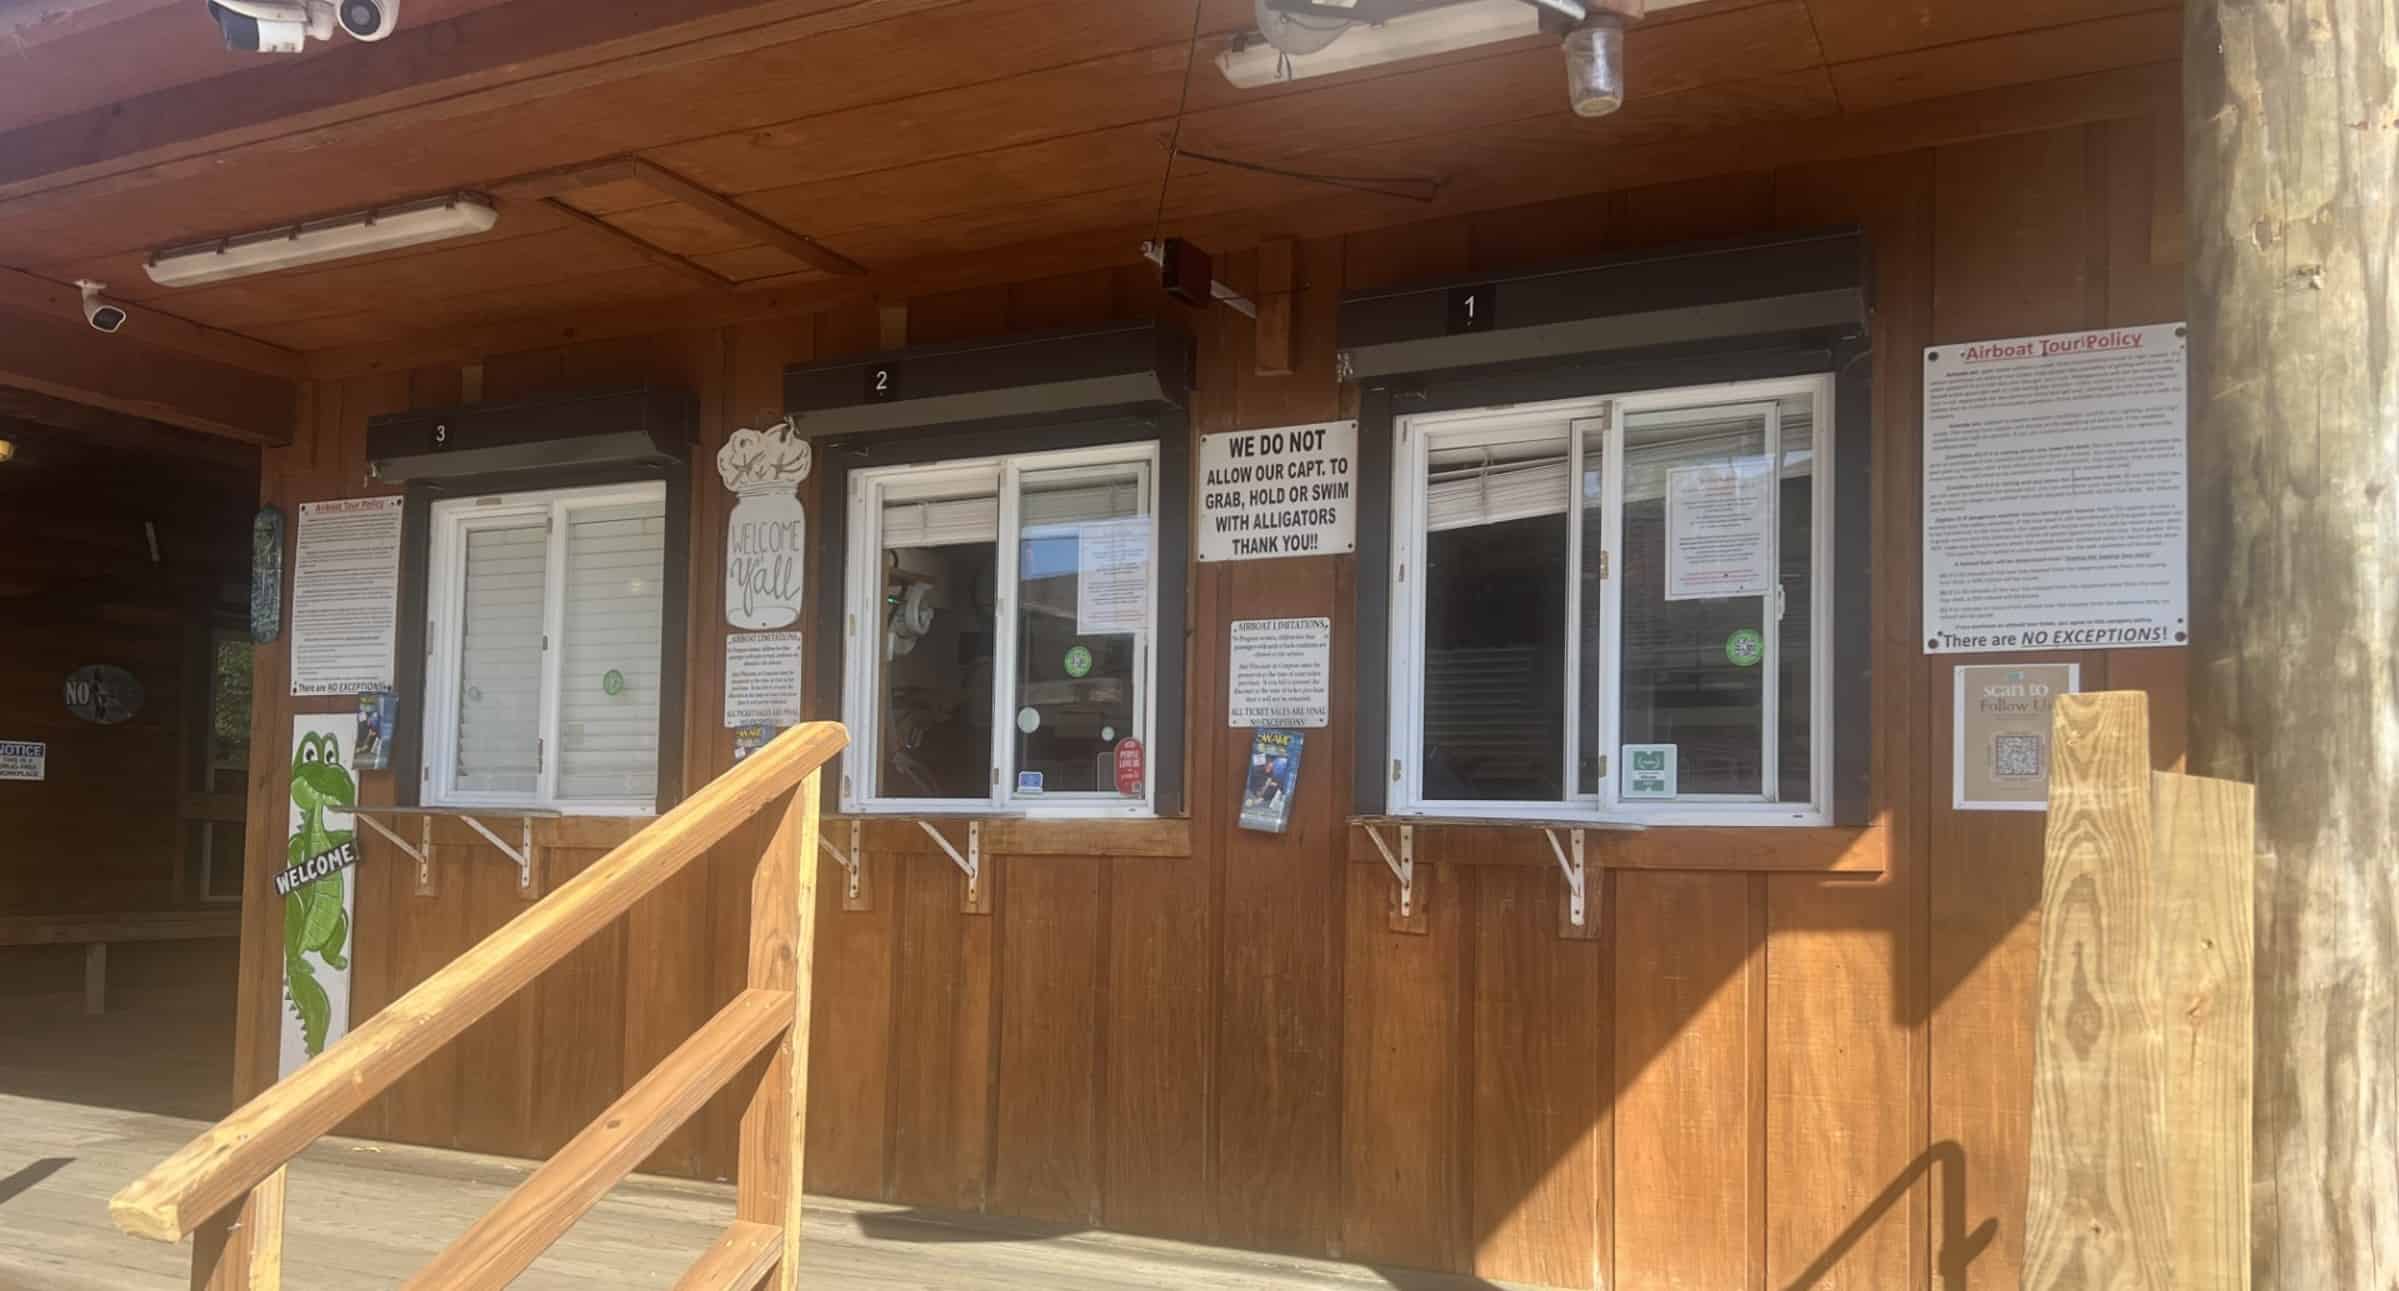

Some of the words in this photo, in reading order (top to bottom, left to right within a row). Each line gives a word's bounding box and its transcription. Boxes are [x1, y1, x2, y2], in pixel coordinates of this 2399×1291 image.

[1465, 295, 1474, 318] 1
[1965, 343, 2033, 360] Airboat
[2040, 339, 2081, 355] Tour
[2086, 333, 2143, 349] Policy
[876, 370, 888, 390] 2
[436, 424, 446, 442] 3
[1230, 436, 1255, 458] WE
[1260, 433, 1284, 456] DO
[1289, 429, 1326, 453] NOT
[1207, 466, 1251, 486] ALLOW
[1255, 463, 1284, 482] OUR
[1288, 460, 1326, 479] CAPT.
[1330, 457, 1349, 475] TO
[1206, 491, 1246, 510] GRAB,
[1249, 488, 1285, 507] HOLD
[1289, 485, 1308, 503] OR
[1312, 481, 1350, 501] SWIM
[1216, 514, 1249, 533] WITH
[1253, 507, 1337, 531] ALLIGATORS
[731, 520, 801, 554] WELCOME
[1232, 535, 1278, 555] THANK
[1282, 533, 1318, 552] YOU!!
[1944, 633, 1987, 649] There
[1991, 635, 2017, 647] are
[2021, 630, 2048, 646] NO
[2052, 626, 2169, 645] EXCEPTIONS!
[66, 680, 90, 705] NO
[1983, 684, 2025, 697] scan
[2030, 682, 2049, 697] to
[1980, 697, 2028, 713] Follow
[275, 843, 355, 895] WELCOME
